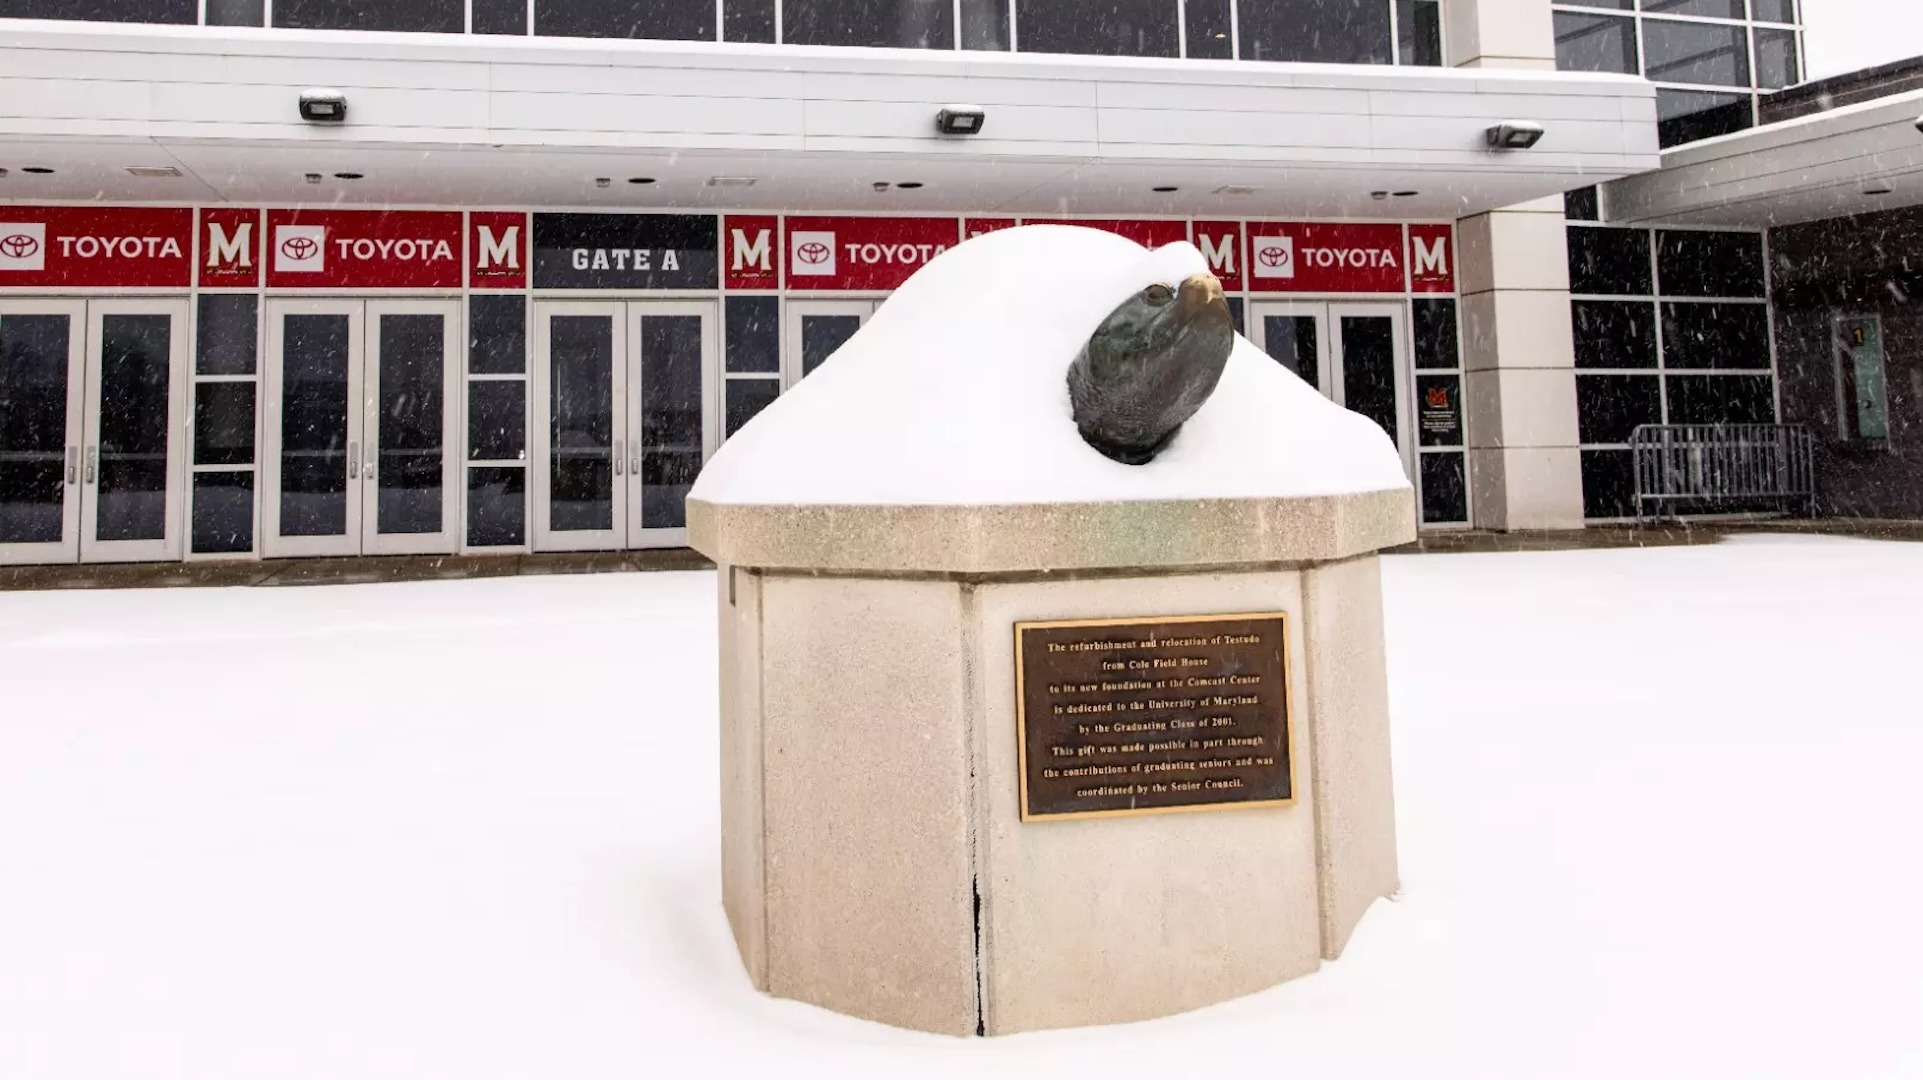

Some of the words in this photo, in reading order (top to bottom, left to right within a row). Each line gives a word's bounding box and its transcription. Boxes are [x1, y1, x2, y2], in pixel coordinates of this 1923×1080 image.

[57, 235, 182, 259] TOYOTA
[206, 222, 253, 267] M
[335, 238, 454, 261] TOYOTA
[476, 225, 520, 269] M
[731, 228, 772, 271] M
[1198, 233, 1236, 274] M
[572, 248, 651, 271] GATE
[661, 249, 680, 271] A
[1301, 247, 1397, 268] TOYOTA
[1412, 236, 1448, 275] M
[1048, 643, 1065, 652] The
[1070, 641, 1137, 651] refurbishment
[1140, 640, 1156, 648] and
[1161, 637, 1207, 647] relocation
[1211, 636, 1220, 644] of
[1224, 634, 1260, 644] Testudo
[1103, 662, 1125, 670] from
[1129, 660, 1149, 669] Cole
[1154, 659, 1177, 668] Field
[1182, 657, 1208, 667] House
[1050, 685, 1060, 693] to
[1063, 684, 1076, 692] its
[1080, 684, 1098, 692] new
[1103, 681, 1152, 691] foundation
[1156, 680, 1165, 688] at
[1170, 679, 1184, 688] the
[1188, 676, 1226, 686] Comcast
[1230, 674, 1261, 684] Center
[1054, 705, 1063, 714] is
[1067, 702, 1113, 713] dedicated
[1117, 702, 1126, 710] to
[1130, 701, 1145, 710] the
[1149, 698, 1196, 709] University
[1200, 697, 1210, 706] of
[1213, 695, 1258, 706] Maryland
[1079, 725, 1090, 735] by
[1095, 723, 1109, 733] the
[1113, 721, 1166, 732] Graduating
[1170, 719, 1195, 729] Class
[1199, 718, 1208, 727] of
[1212, 717, 1236, 727] 2001.
[1052, 746, 1073, 756] This
[1078, 745, 1096, 756] gift
[1100, 745, 1117, 753] was
[1121, 743, 1145, 752] made
[1149, 741, 1186, 752] possible
[1190, 740, 1199, 749] in
[1203, 739, 1223, 749] part
[1227, 736, 1264, 746] through
[1044, 768, 1059, 778] the
[1063, 765, 1127, 776] contributions
[1131, 763, 1141, 772] of
[1144, 761, 1195, 773] graduating
[1199, 759, 1232, 769] seniors
[1236, 757, 1252, 766] and
[1256, 757, 1273, 765] was
[1077, 785, 1133, 796] coordinated
[1137, 784, 1148, 795] by
[1152, 783, 1167, 792] the
[1171, 781, 1201, 791] Senior
[1205, 778, 1244, 789] Council.
